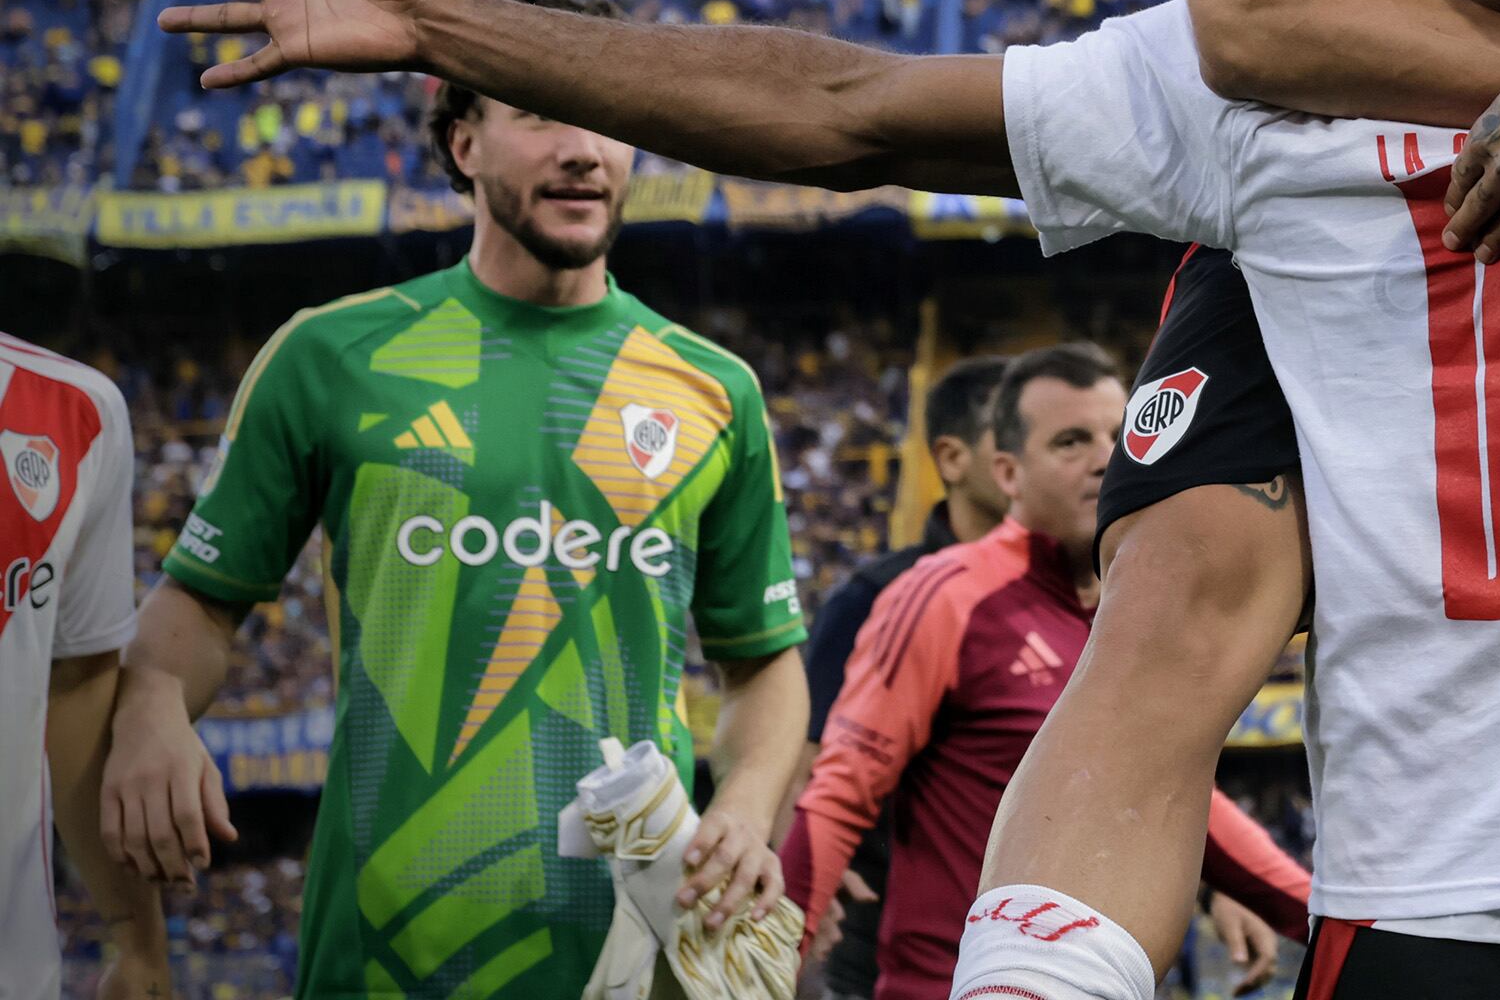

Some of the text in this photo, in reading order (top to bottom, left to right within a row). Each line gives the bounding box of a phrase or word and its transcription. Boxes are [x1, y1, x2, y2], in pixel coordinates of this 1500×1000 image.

[1376, 131, 1425, 182] LA
[1134, 391, 1184, 434] CARP
[397, 499, 674, 577] codere
